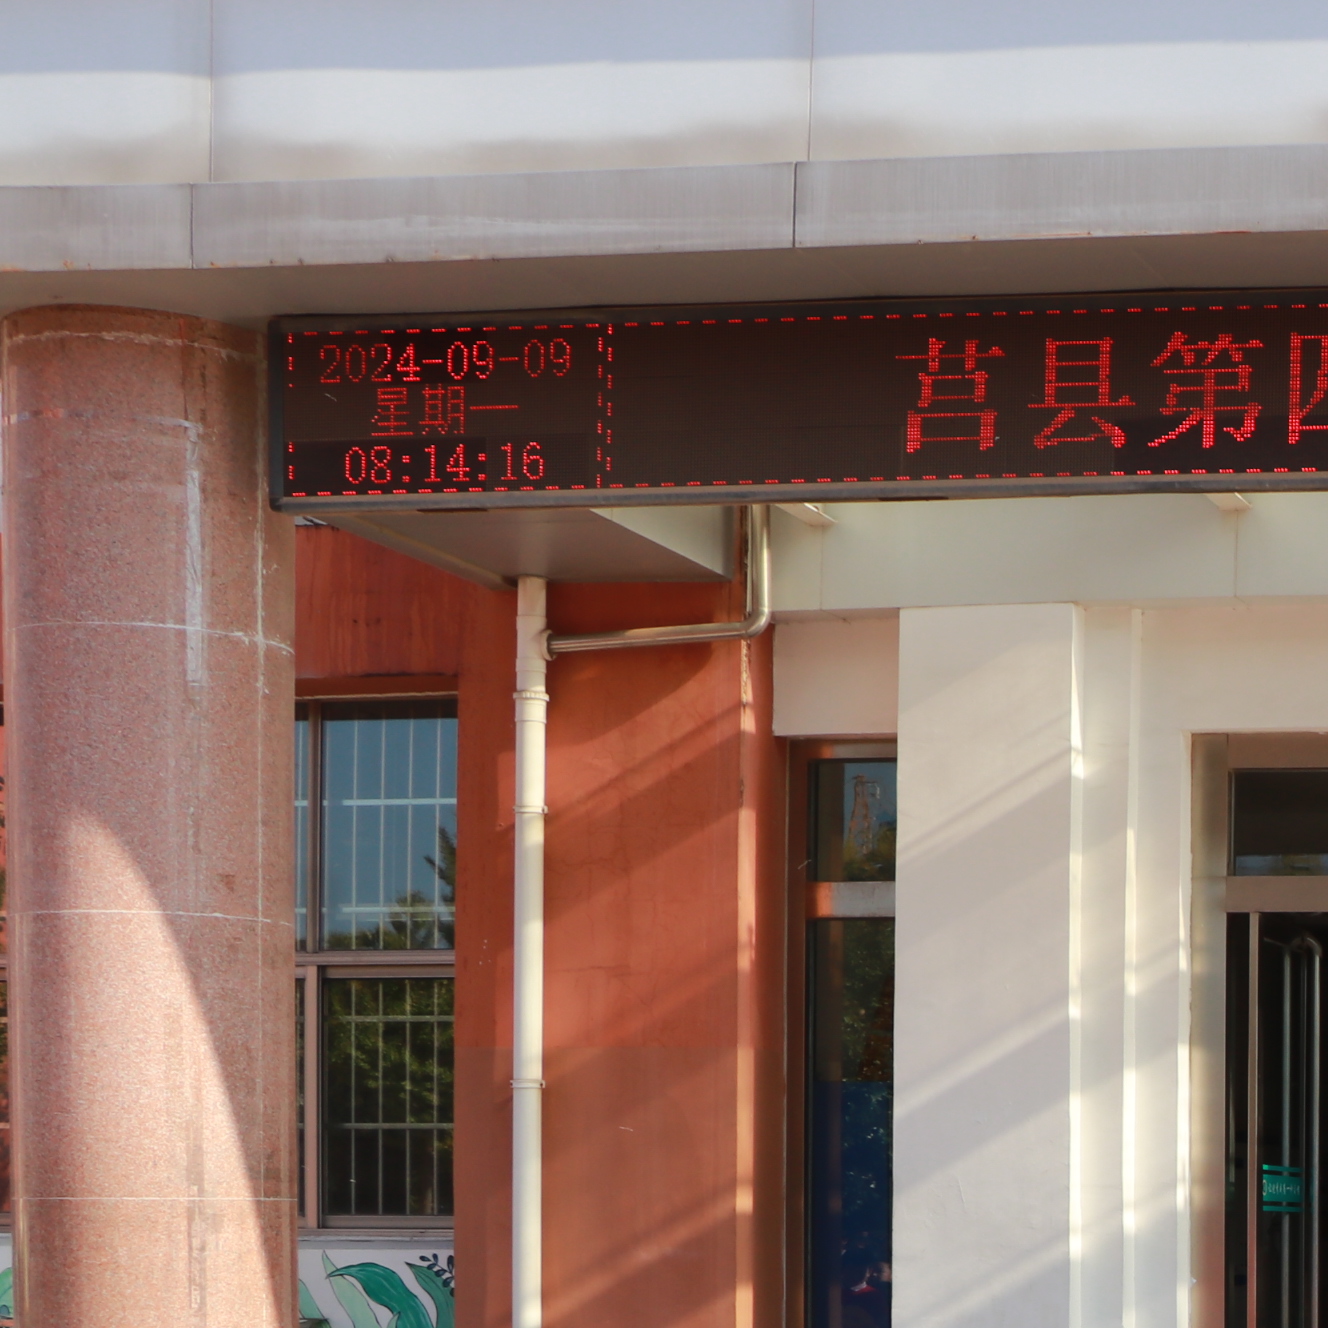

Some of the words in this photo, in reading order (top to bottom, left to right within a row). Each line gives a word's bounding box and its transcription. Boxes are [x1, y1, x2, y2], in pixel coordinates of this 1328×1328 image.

[318, 337, 573, 385] 2024-09-09
[371, 386, 521, 437] 星期一
[342, 440, 546, 486] 08:14:16
